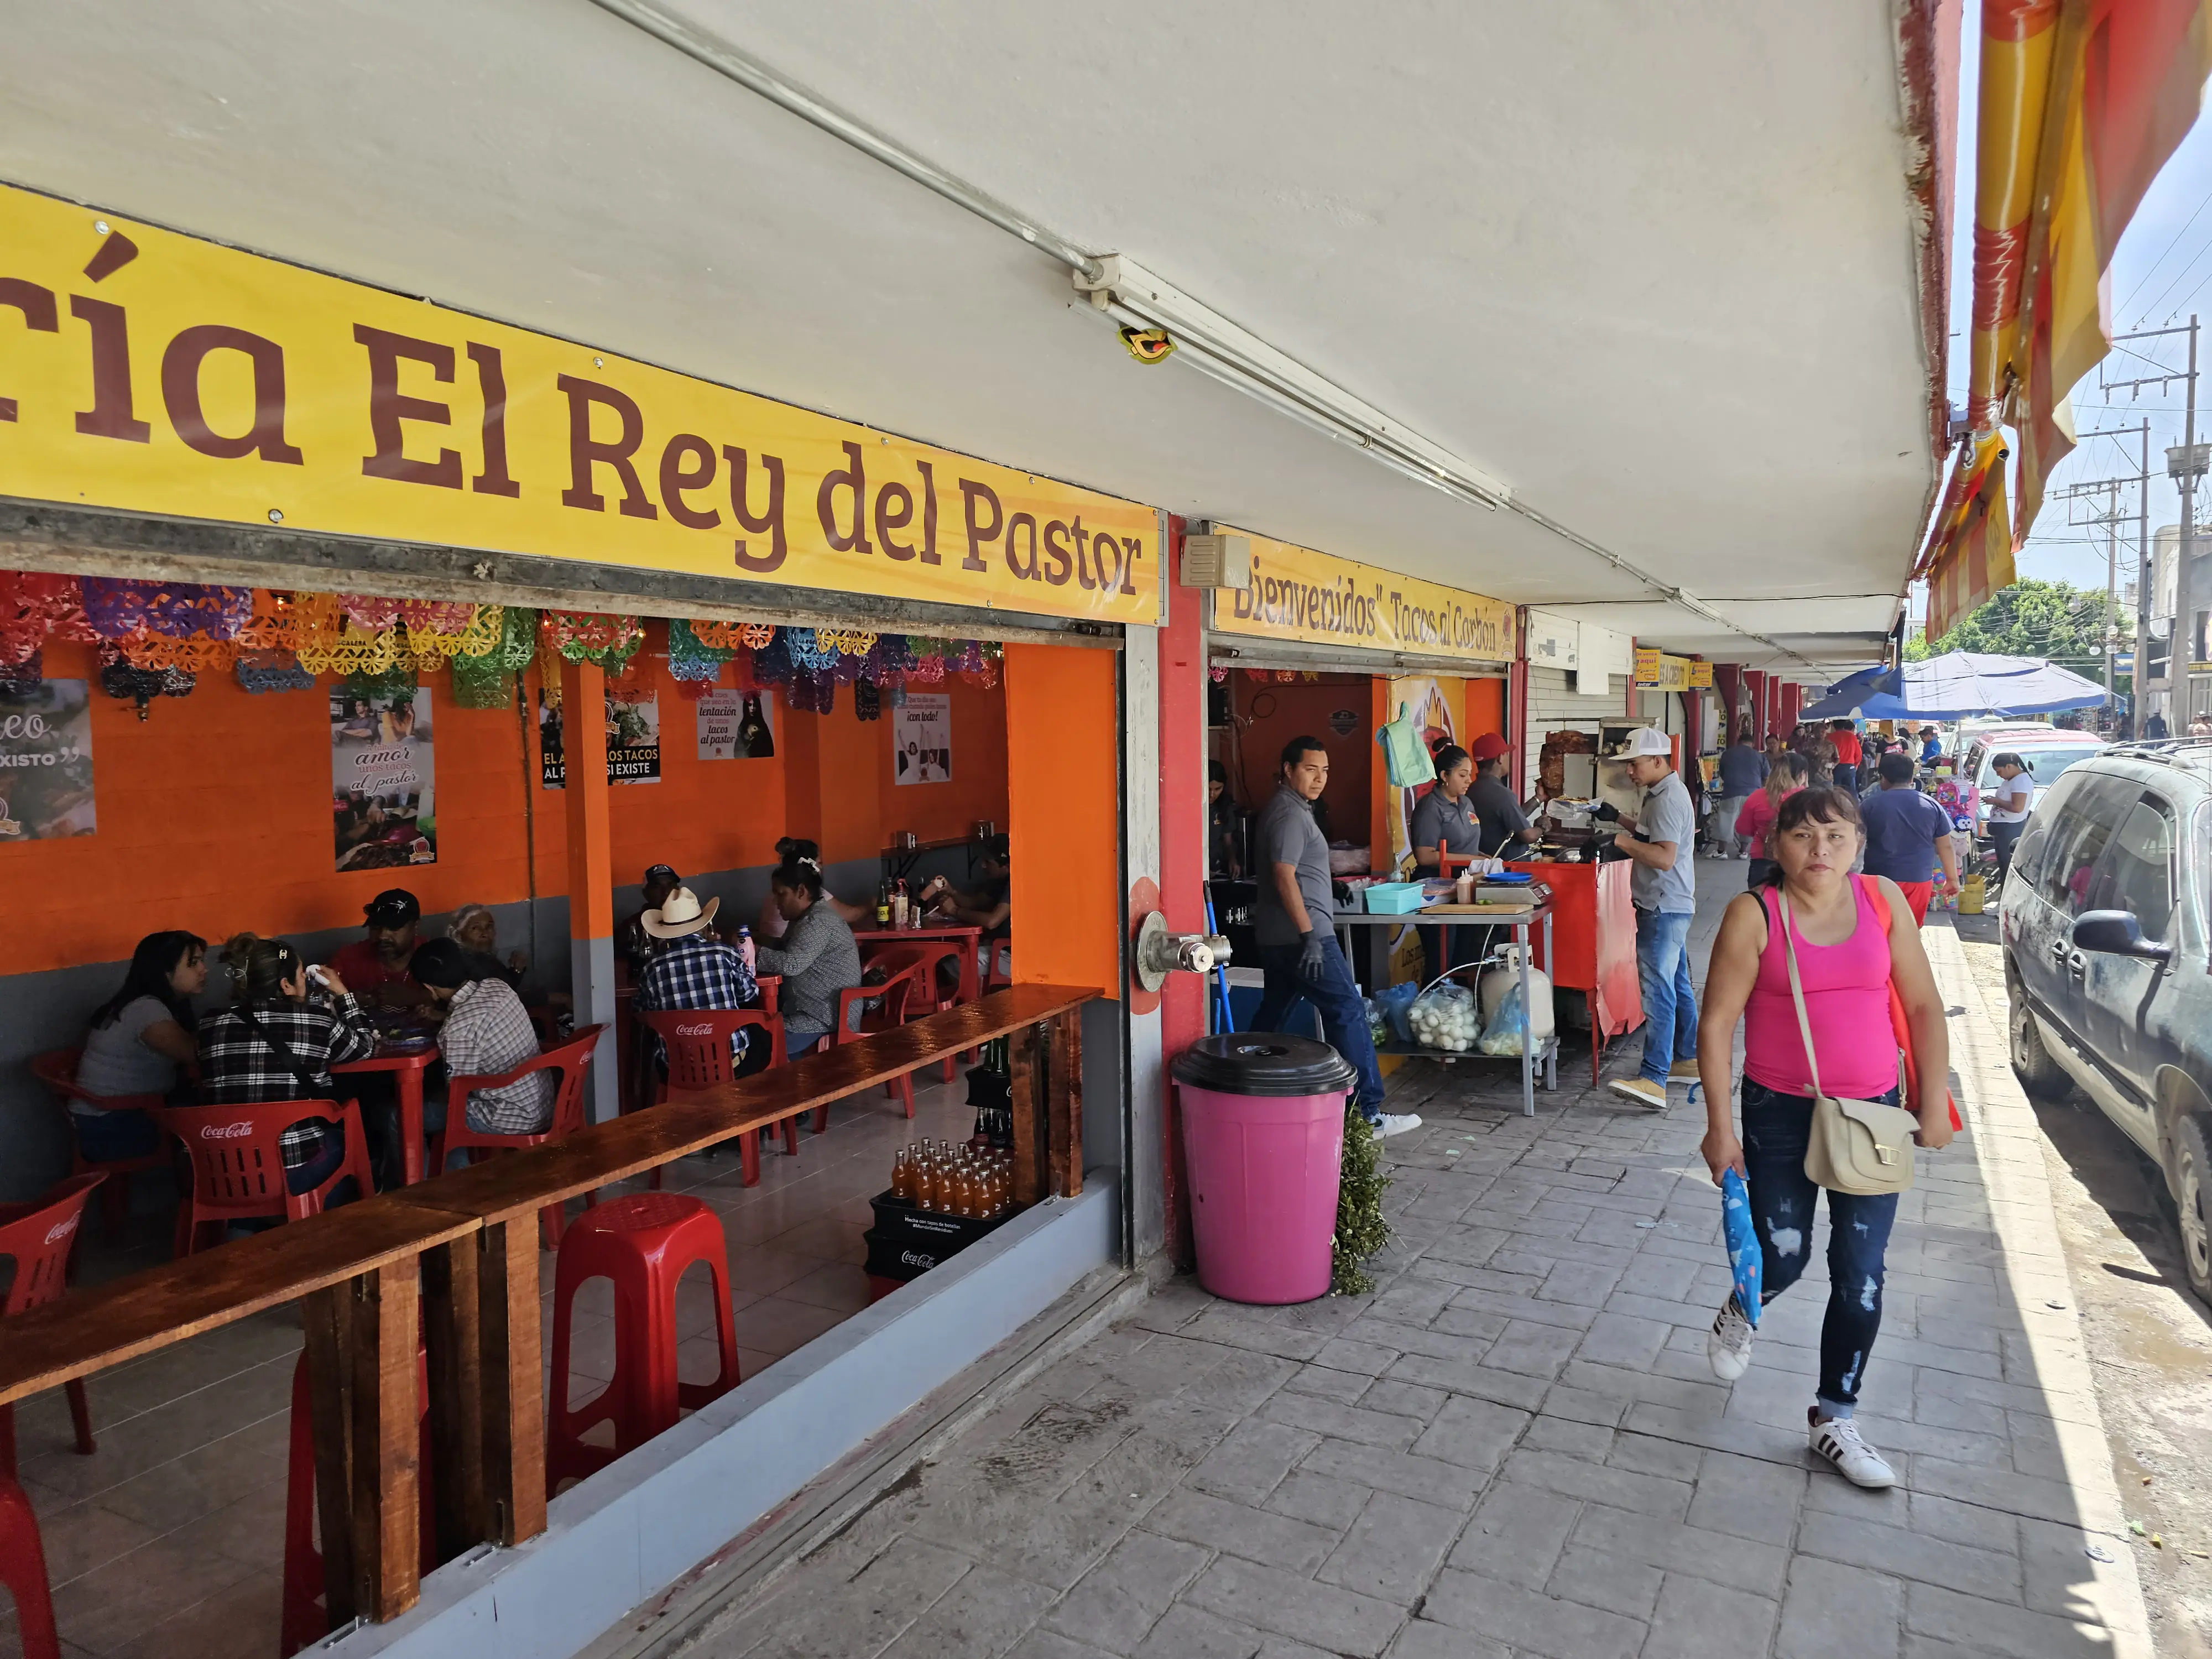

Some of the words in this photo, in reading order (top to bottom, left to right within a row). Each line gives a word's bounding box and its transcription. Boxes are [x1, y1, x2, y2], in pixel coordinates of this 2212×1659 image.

[352, 322, 519, 498] El
[557, 373, 787, 572] Rey
[817, 440, 941, 565] del
[958, 478, 1142, 596] Pastor
[1391, 592, 1437, 644] Tacos
[1439, 602, 1451, 646] al
[1454, 604, 1496, 652] Carbón
[699, 706, 736, 716] tentación
[921, 711, 938, 721] todo!
[708, 725, 728, 734] tacos
[701, 734, 709, 744] al
[709, 735, 735, 747] pastor
[355, 747, 411, 765] amor
[544, 753, 557, 764] EL
[607, 750, 623, 761] OS
[624, 749, 658, 760] TACOS
[359, 764, 383, 773] unos
[385, 763, 411, 771] tacos
[544, 767, 558, 779] AL
[607, 764, 614, 775] SI
[616, 763, 650, 775] EXISTE
[351, 774, 372, 790] al
[366, 770, 417, 795] pastor
[676, 1022, 715, 1036] Coca-Cola
[201, 1120, 254, 1139] Coca-Cola
[901, 1250, 935, 1269] Coca-Cola
